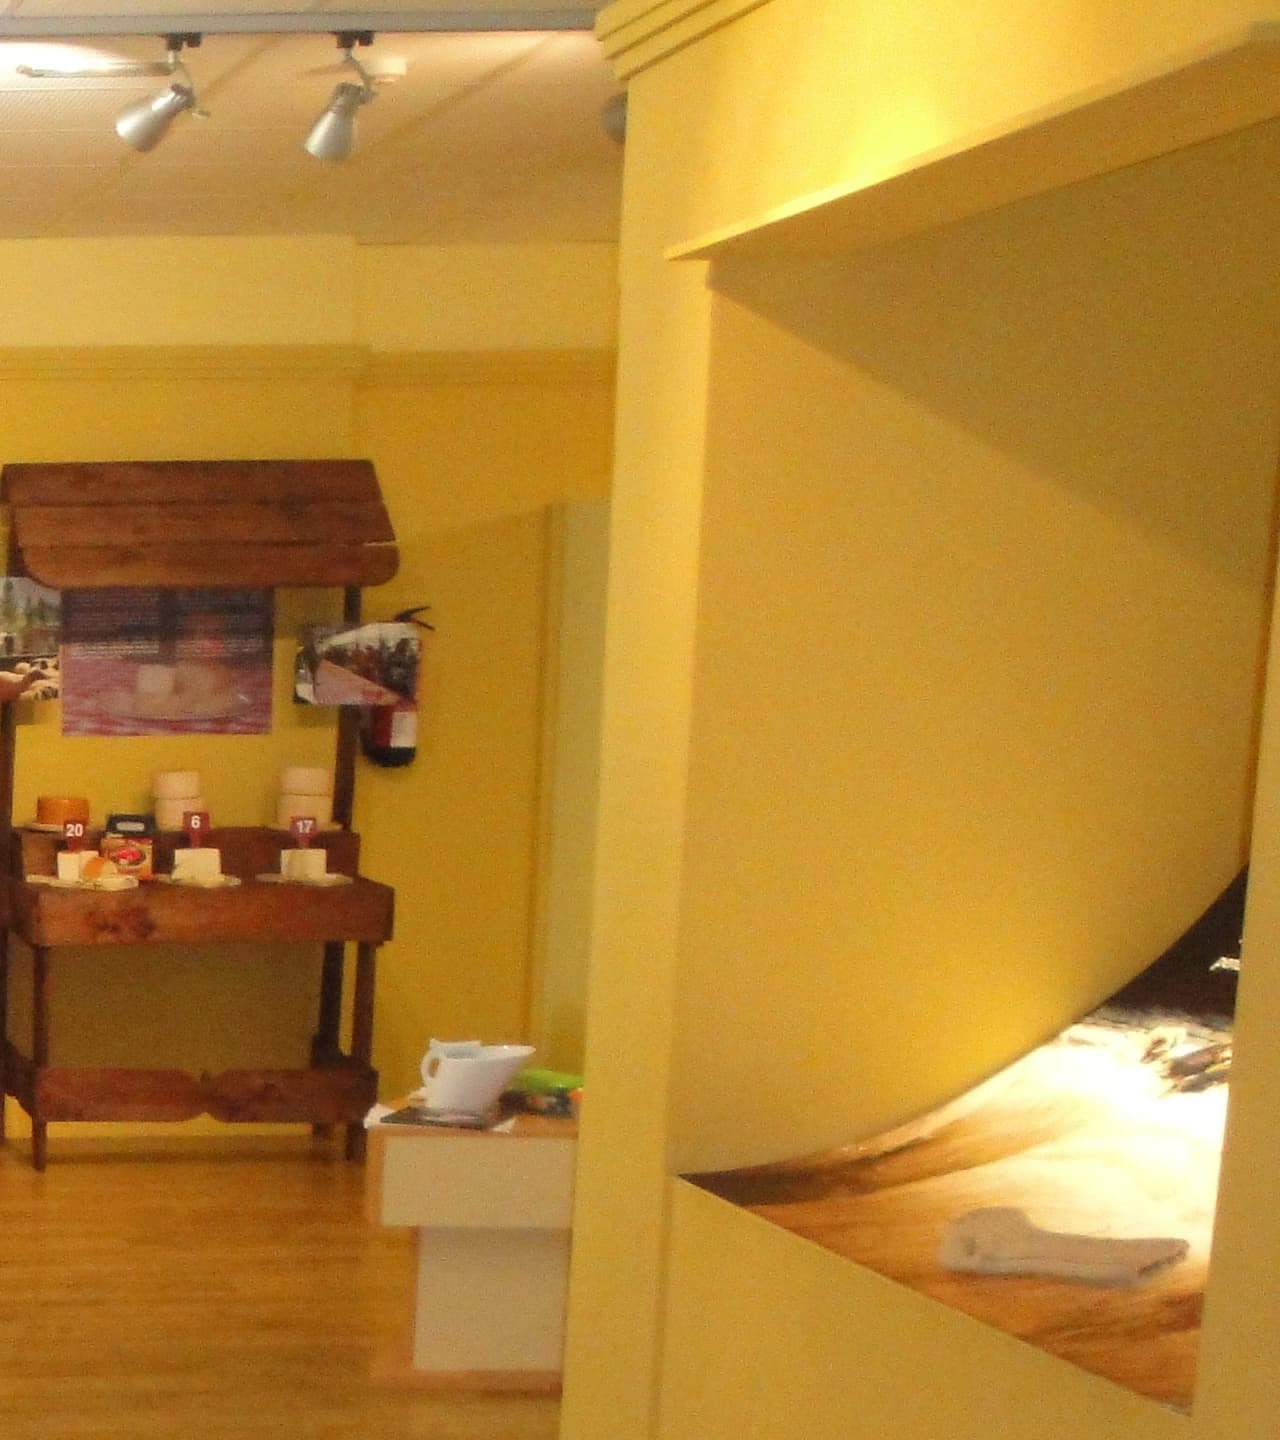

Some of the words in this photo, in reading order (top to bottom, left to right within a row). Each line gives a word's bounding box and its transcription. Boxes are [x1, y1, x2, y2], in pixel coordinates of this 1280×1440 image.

[191, 815, 200, 829] 6
[296, 820, 313, 834] 17
[66, 823, 83, 837] 20
